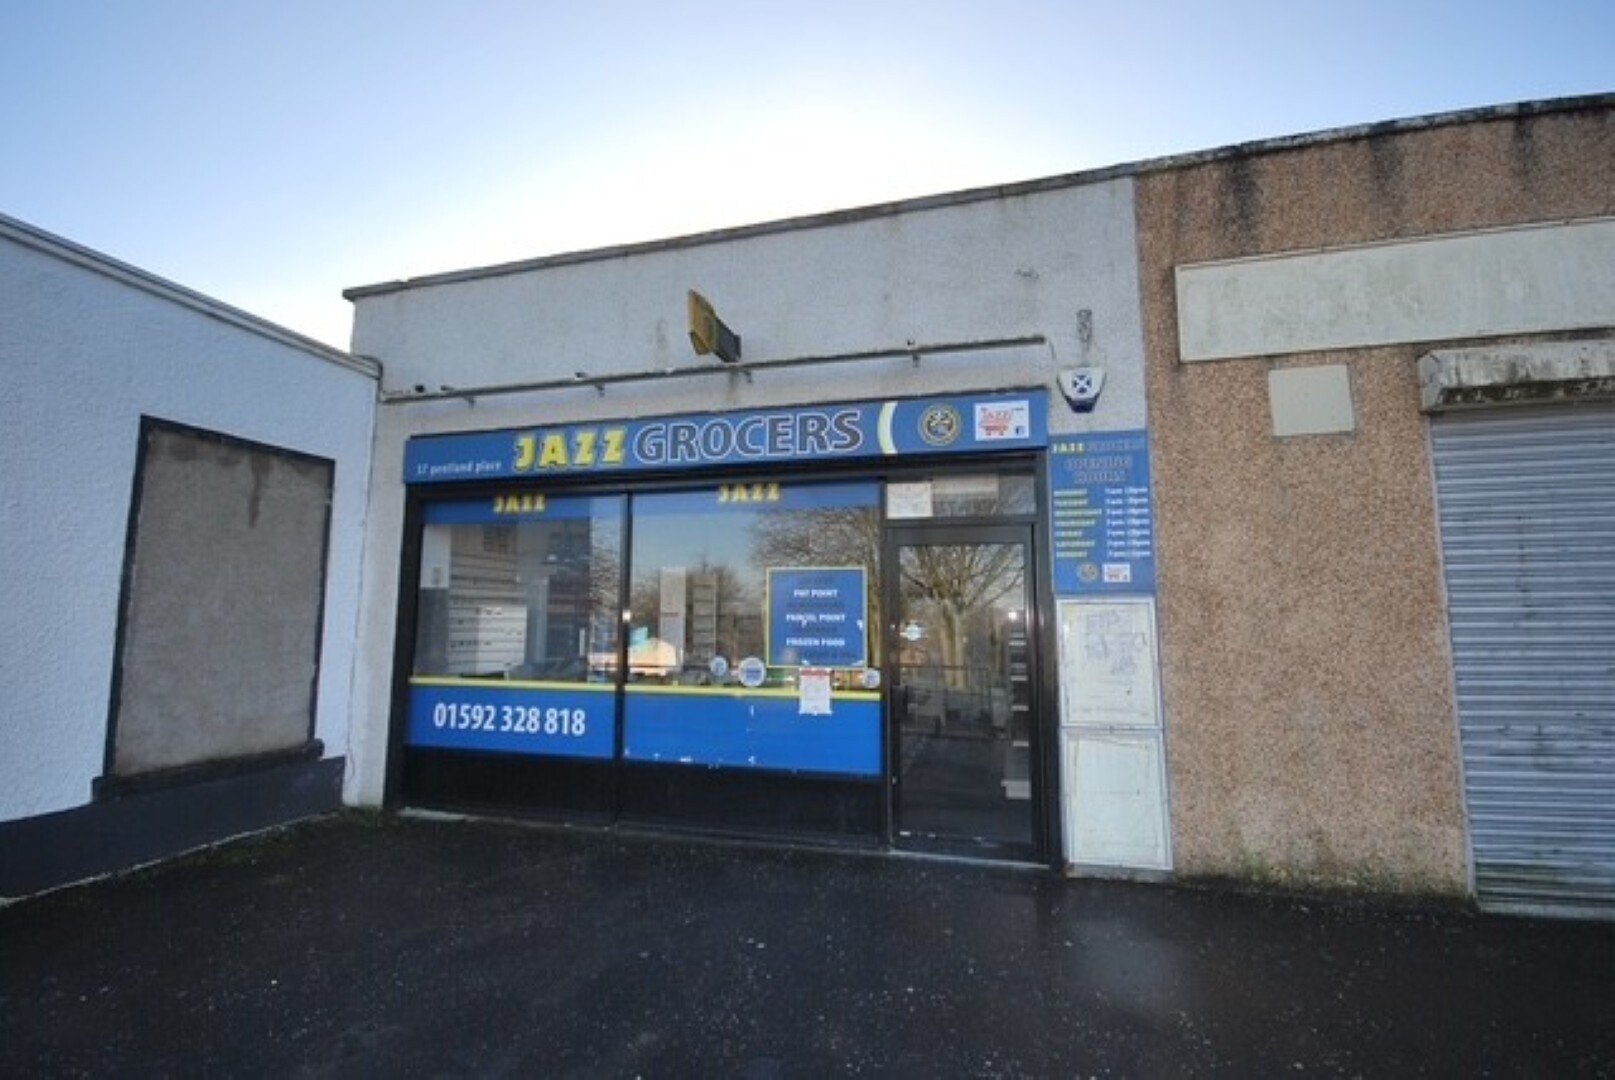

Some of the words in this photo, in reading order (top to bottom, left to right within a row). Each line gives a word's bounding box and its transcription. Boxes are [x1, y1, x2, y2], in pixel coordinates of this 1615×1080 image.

[514, 425, 627, 471] JAZZ
[633, 410, 864, 464] GROCERS
[493, 494, 546, 513] JAZZ
[718, 483, 781, 502] JAZZ
[433, 702, 496, 731] 01592
[500, 704, 541, 733] 328
[544, 707, 586, 737] 818
